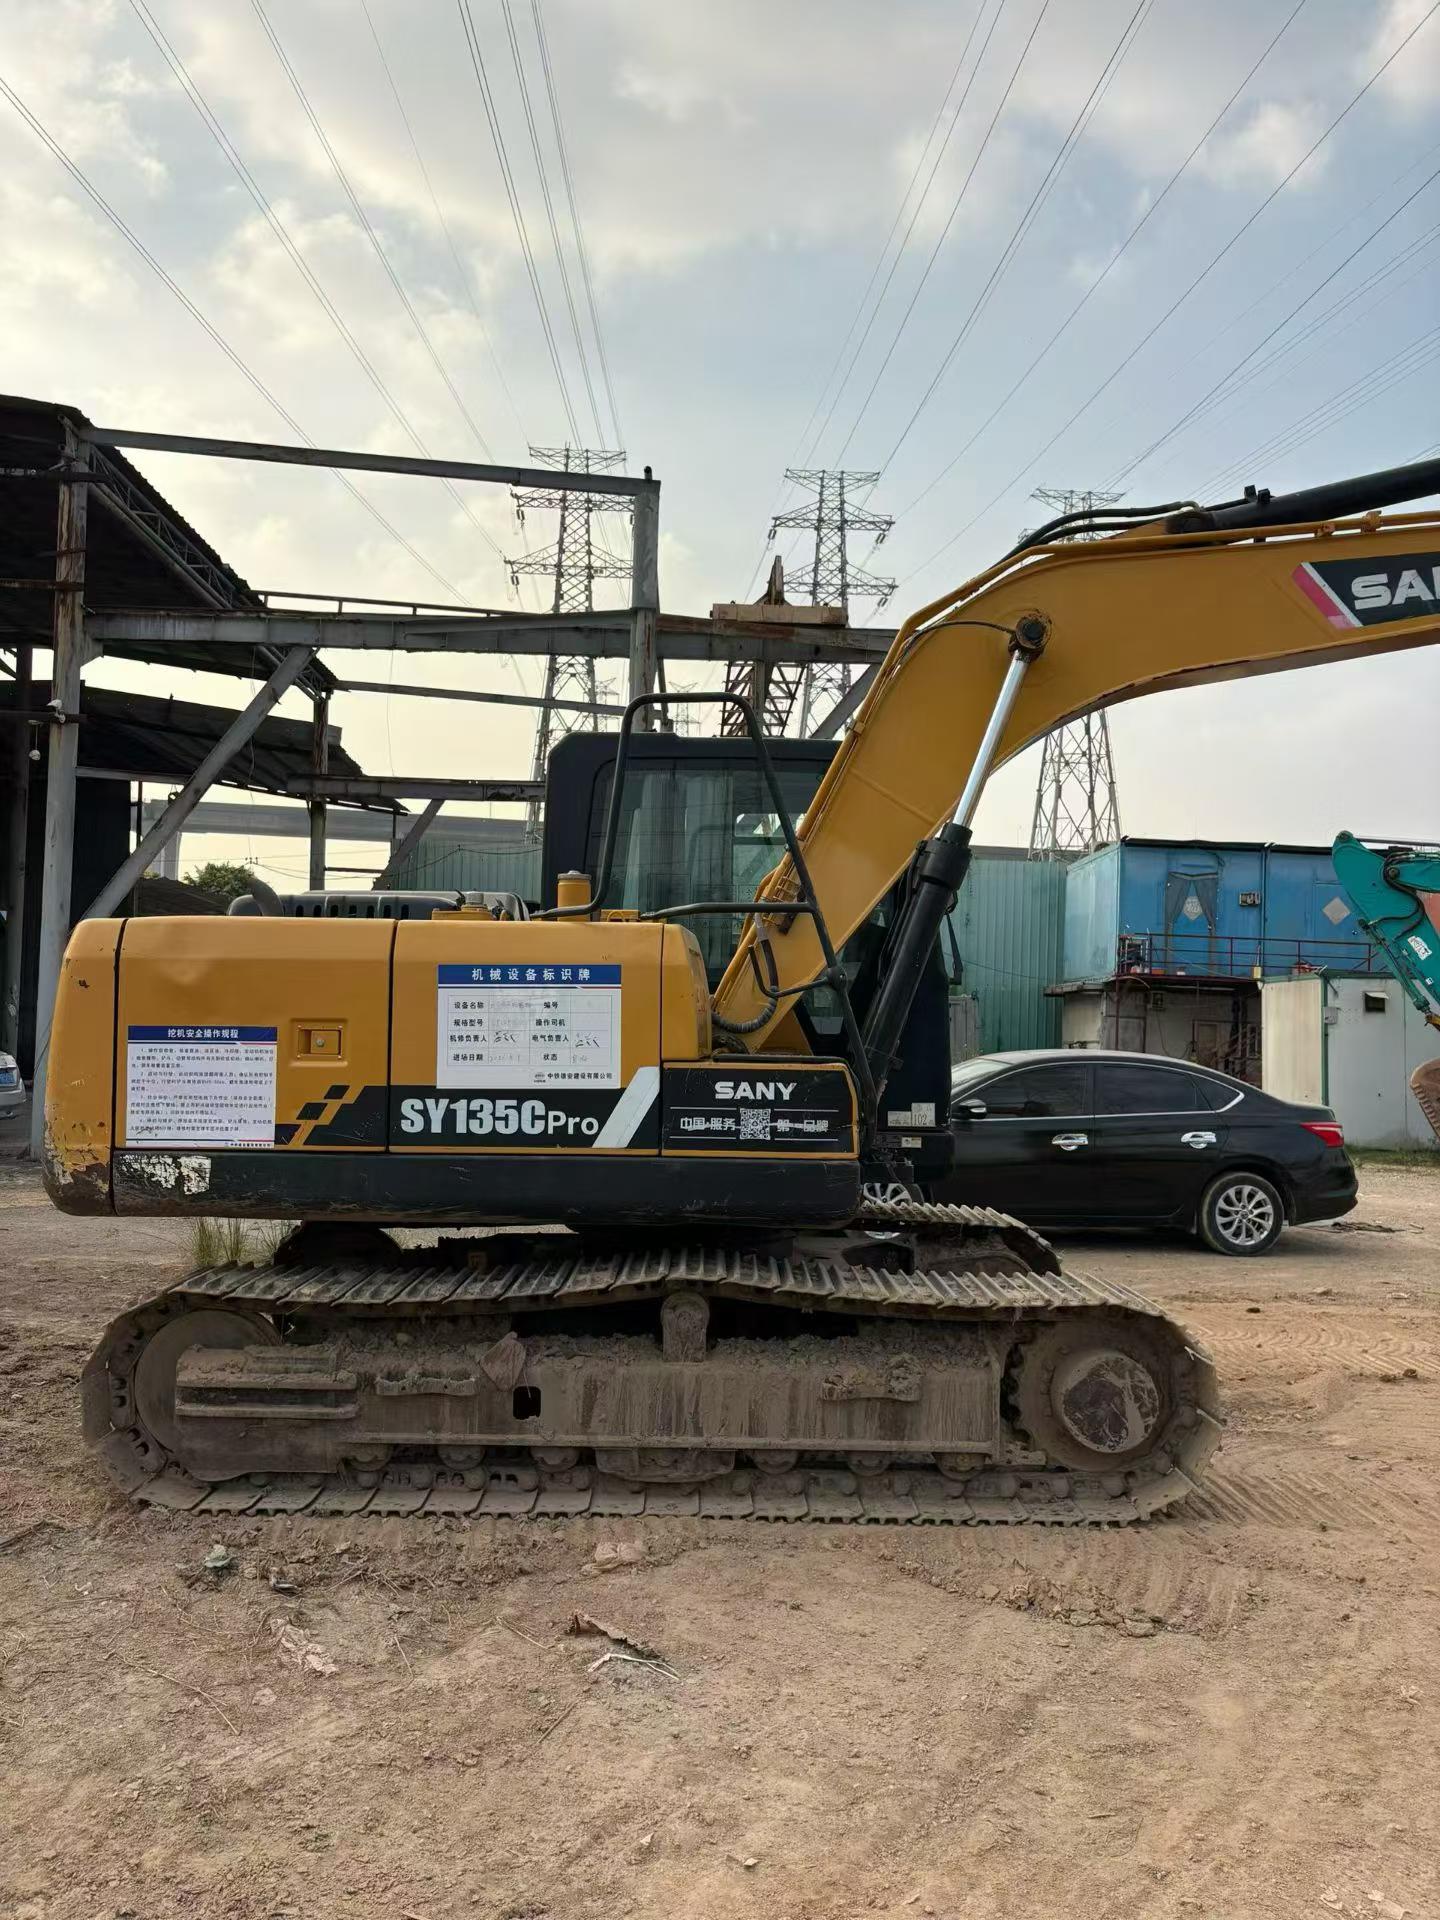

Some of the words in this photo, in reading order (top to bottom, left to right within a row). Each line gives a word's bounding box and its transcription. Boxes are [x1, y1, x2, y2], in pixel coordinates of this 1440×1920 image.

[1351, 566, 1440, 610] SA
[471, 967, 591, 982] 机械设备标识牌
[453, 1001, 485, 1010] 设备名称
[543, 1001, 559, 1010] 编号
[453, 1018, 484, 1027] 规格型号
[535, 1018, 566, 1027] 操作司机
[167, 1028, 239, 1039] 挖机安全操作规程
[449, 1034, 488, 1043] 机修负责人
[531, 1034, 570, 1043] 电气负责人
[453, 1053, 484, 1062] 进场日期
[543, 1053, 558, 1062] 状态
[714, 1081, 797, 1100] SANY
